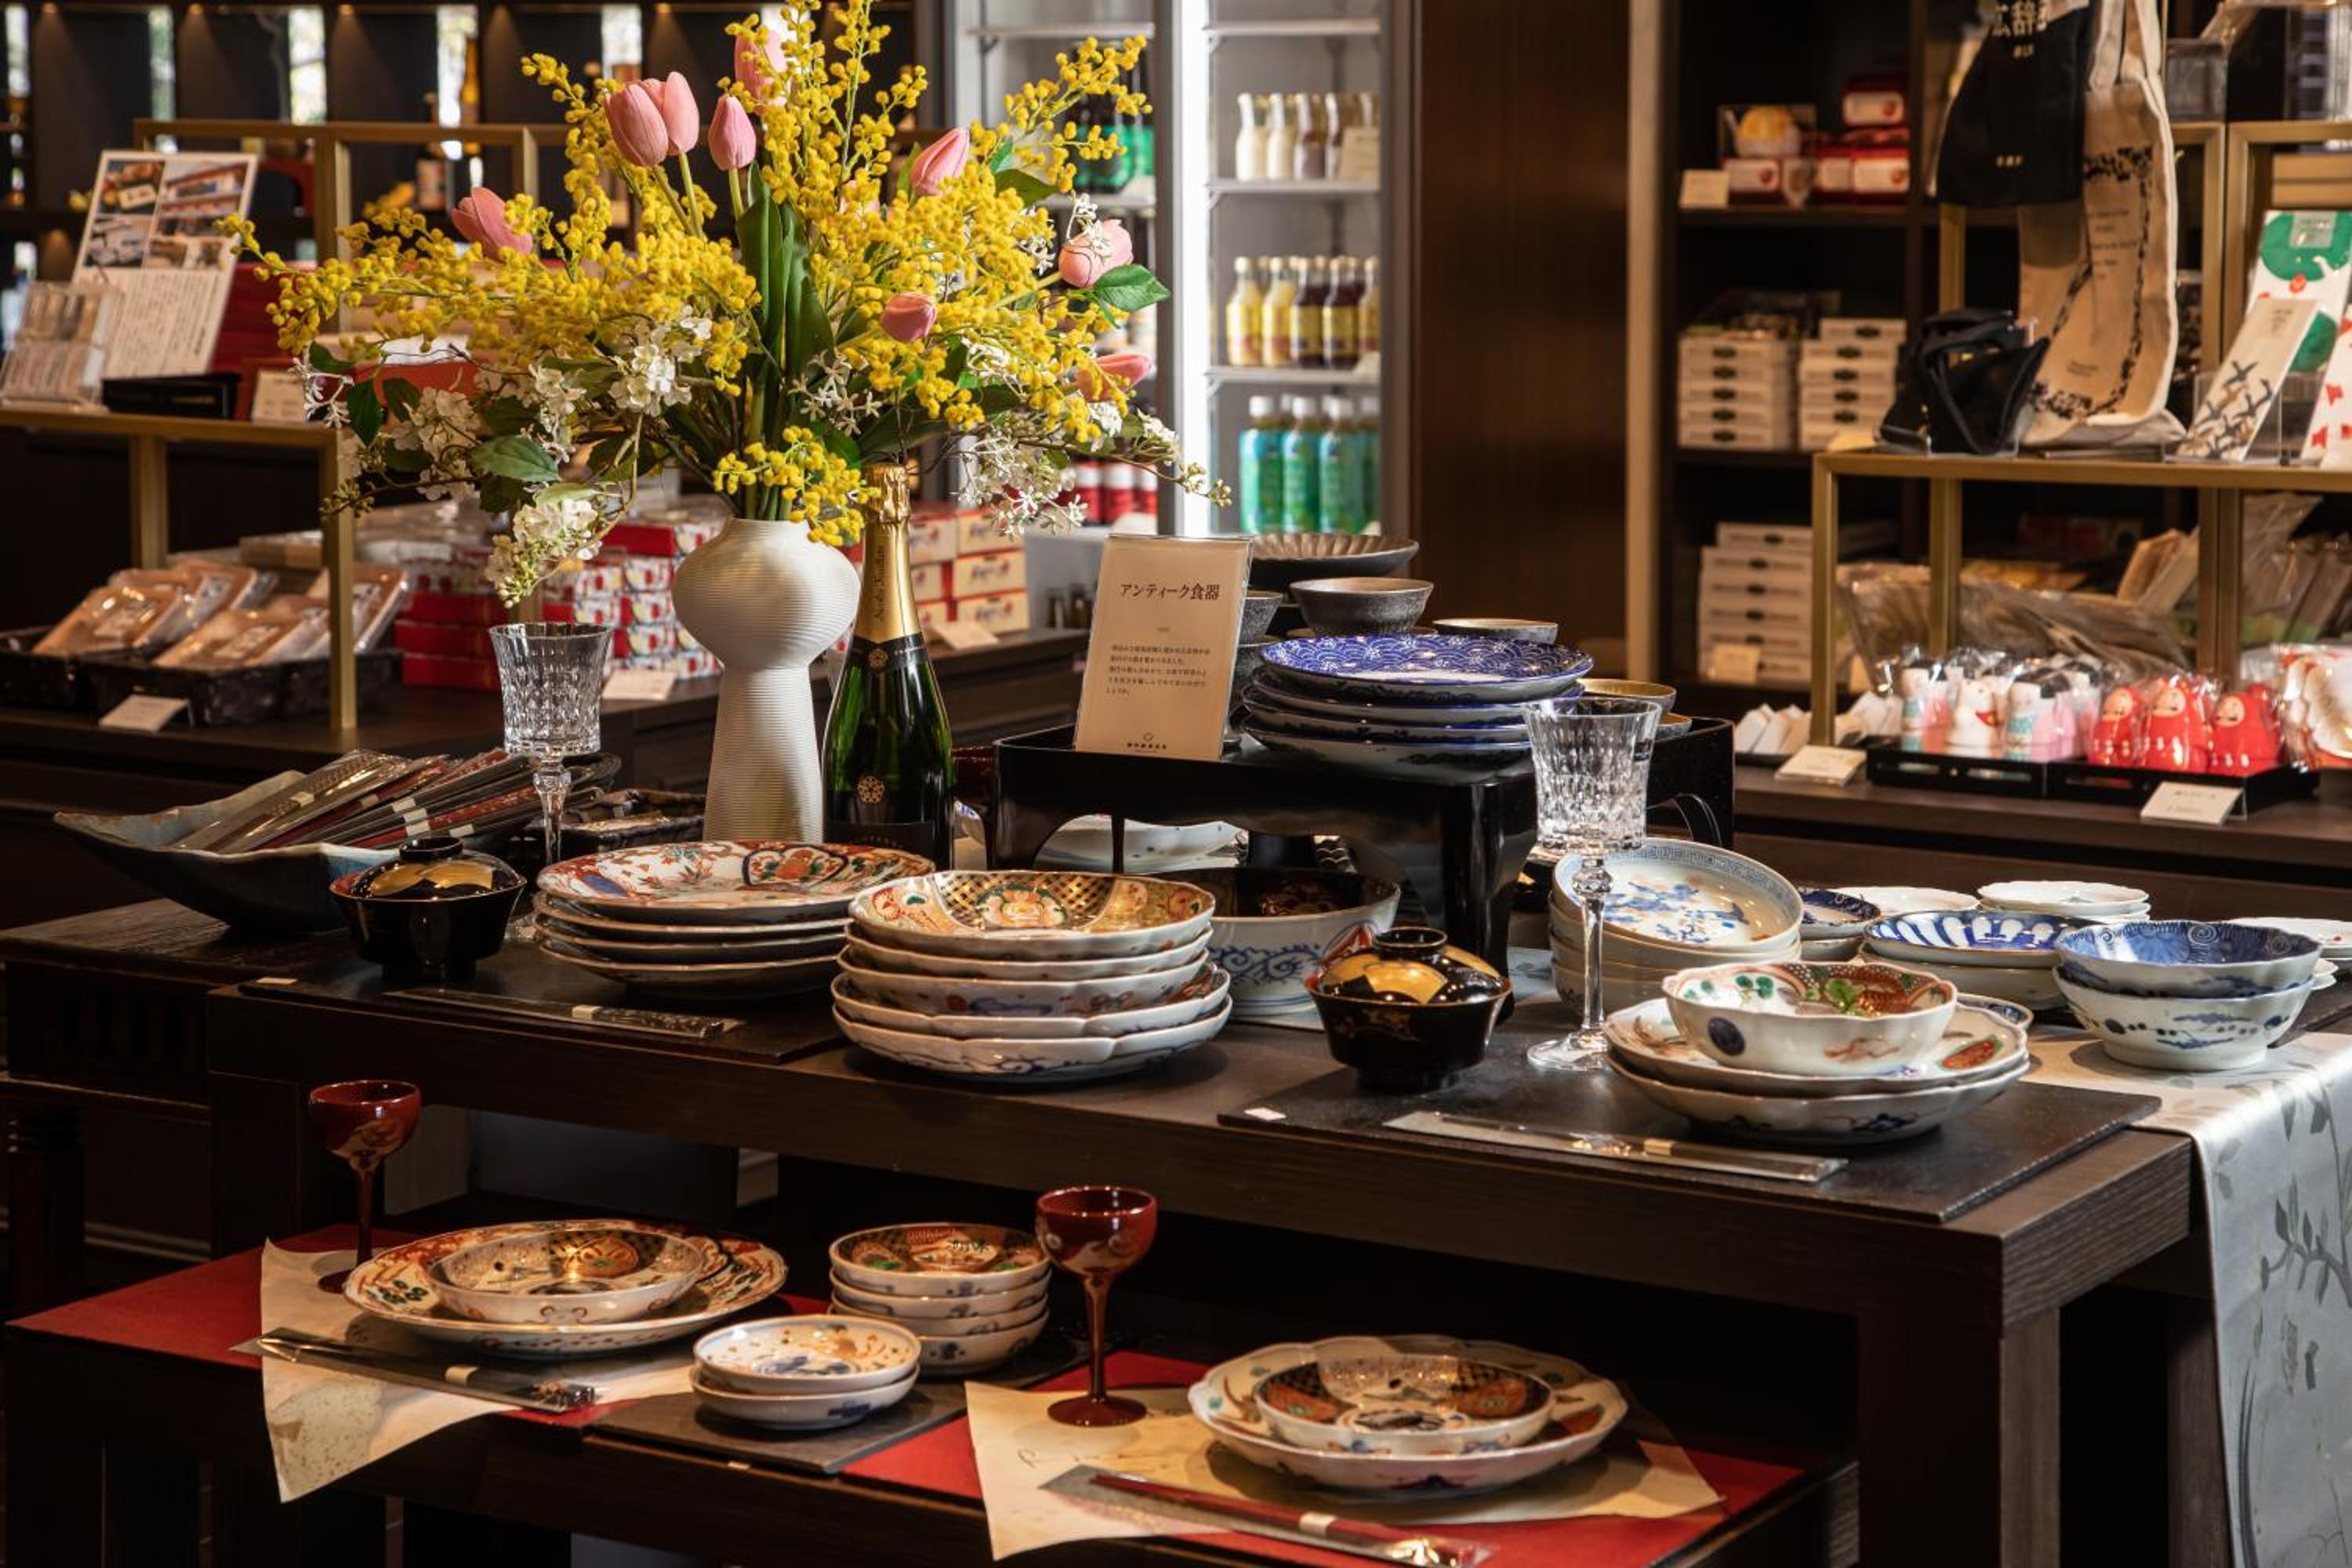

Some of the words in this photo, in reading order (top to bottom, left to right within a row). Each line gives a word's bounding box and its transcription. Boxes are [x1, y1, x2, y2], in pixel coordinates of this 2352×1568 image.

[1120, 583, 1219, 601] アンティーク食器
